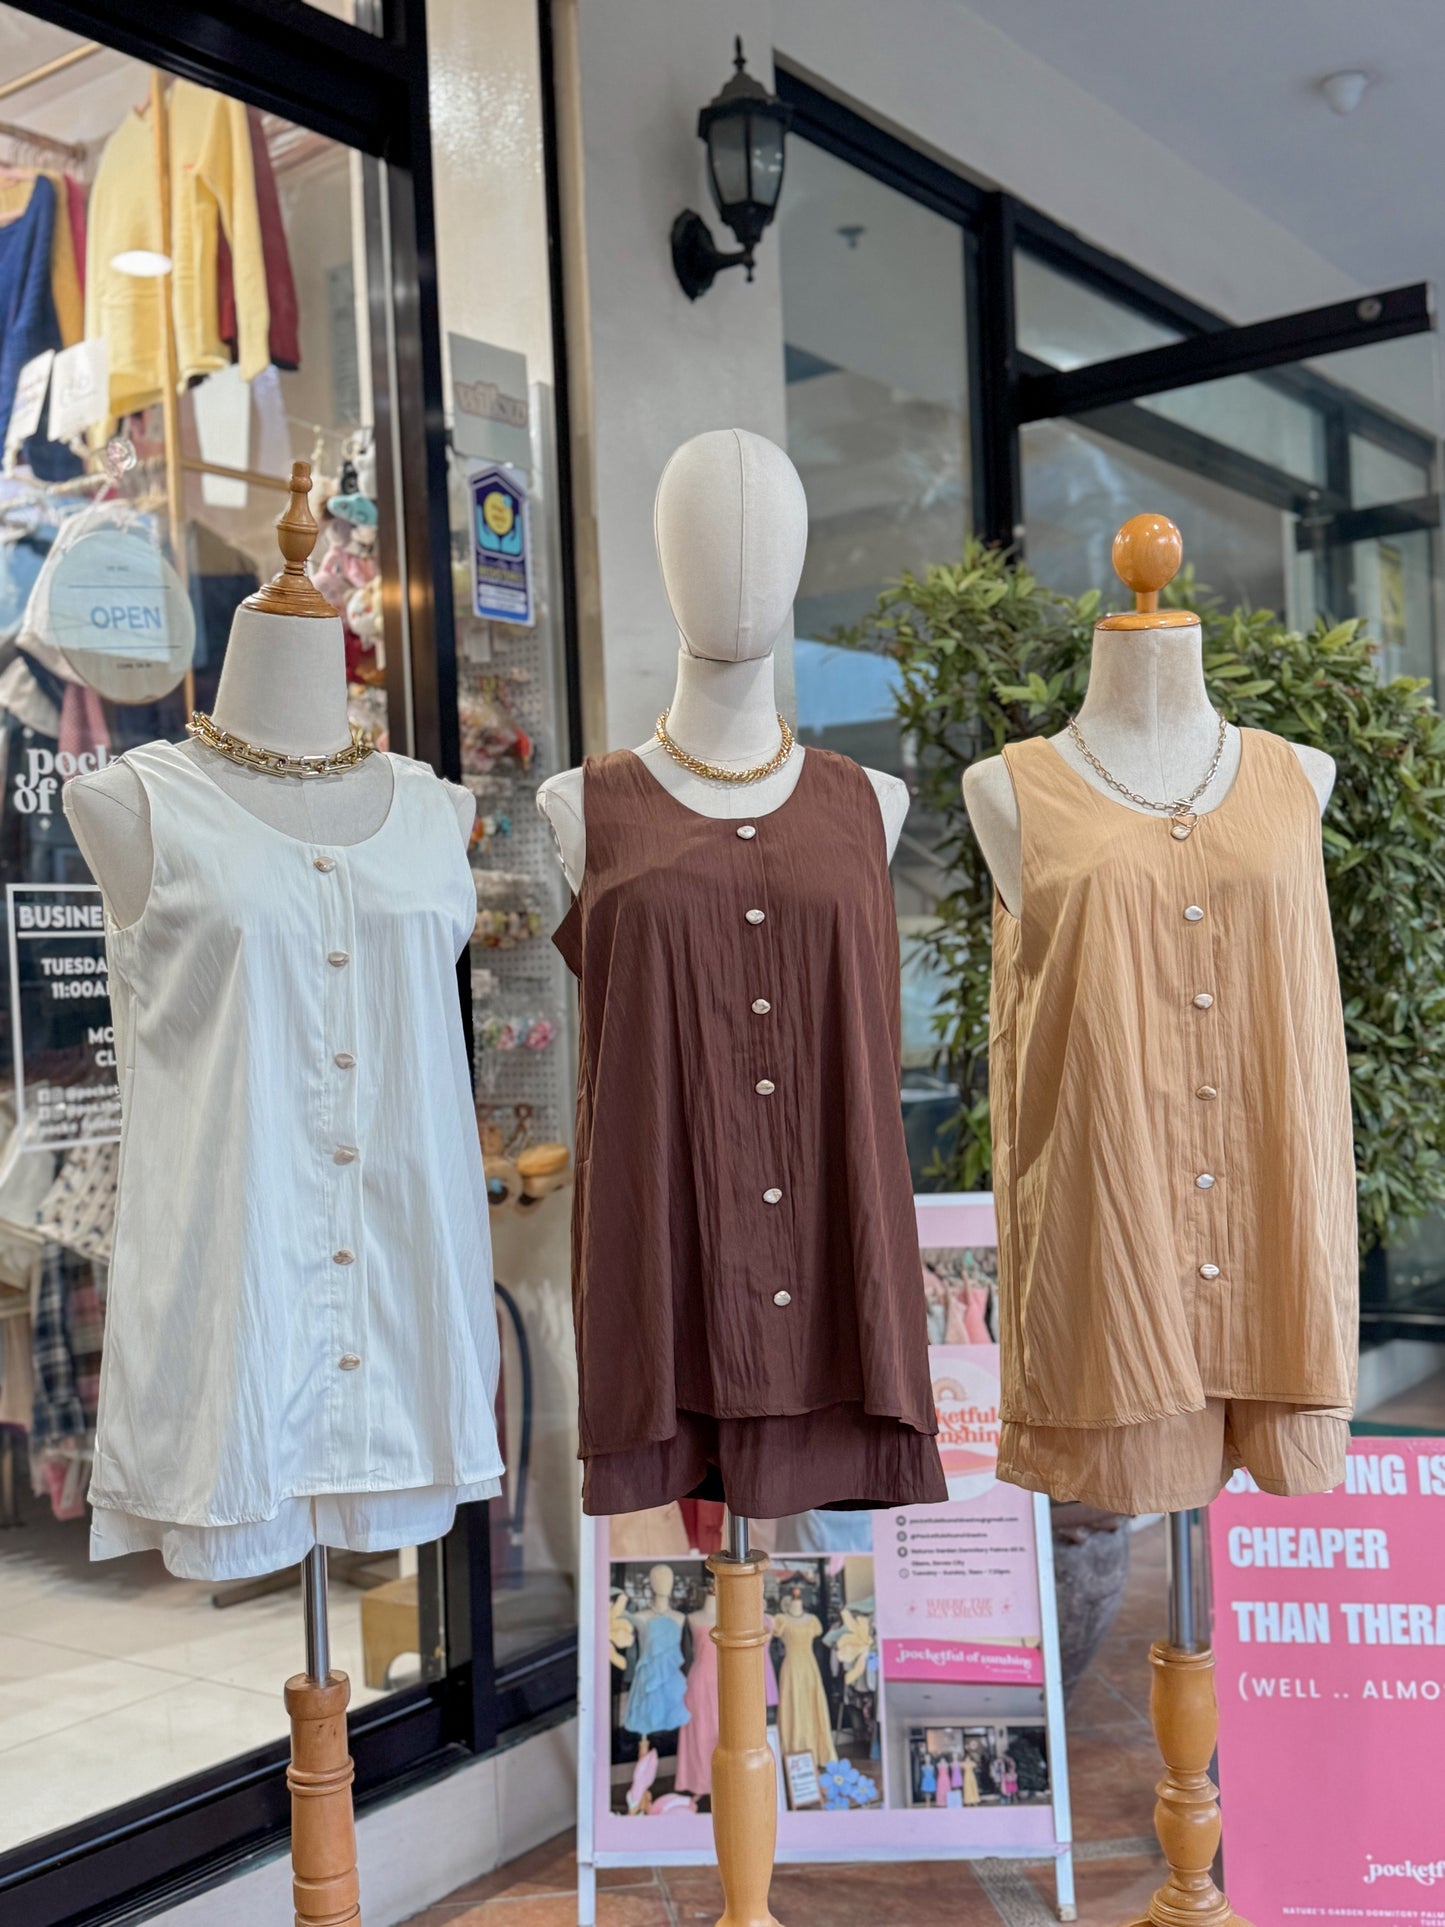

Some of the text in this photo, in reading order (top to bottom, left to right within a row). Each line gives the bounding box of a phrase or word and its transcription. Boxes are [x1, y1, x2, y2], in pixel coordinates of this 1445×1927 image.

[90, 606, 162, 629] OPEN
[13, 777, 58, 815] of
[51, 981, 109, 999] 11:00A
[1418, 1456, 1445, 1496] IS
[1228, 1526, 1389, 1569] CHEAPER
[1232, 1602, 1331, 1643] THAN
[1362, 1680, 1445, 1701] ALMO
